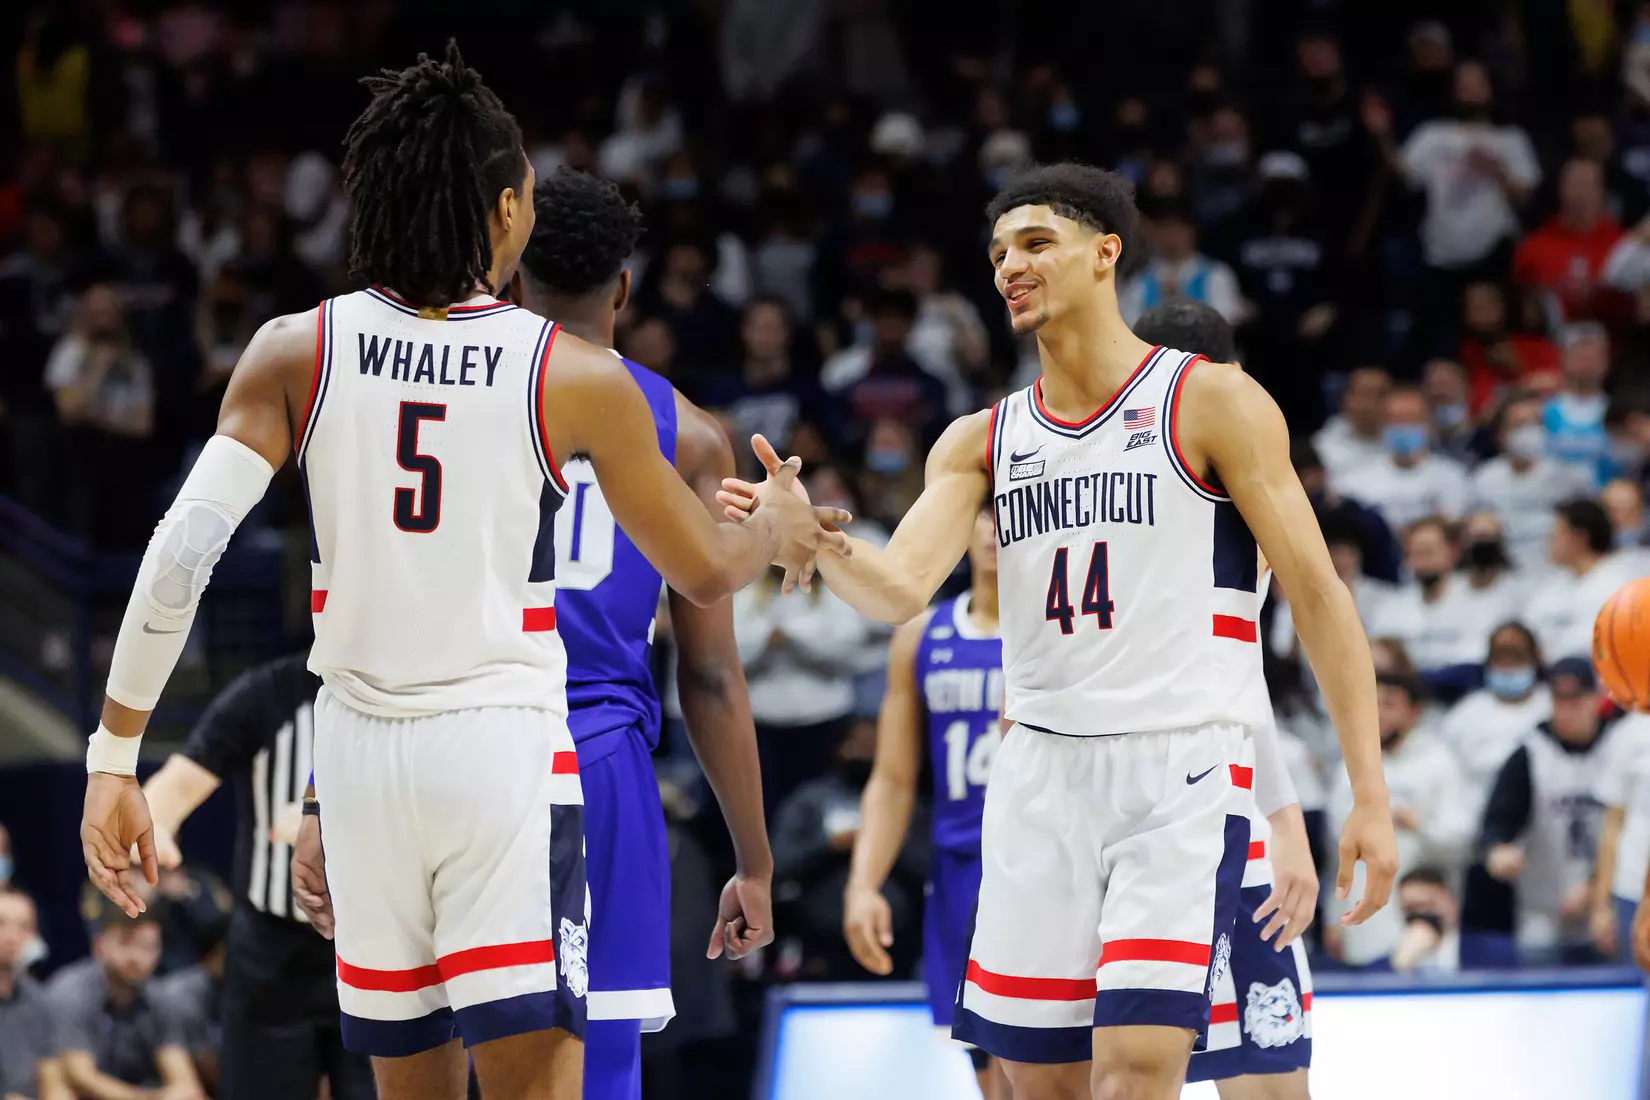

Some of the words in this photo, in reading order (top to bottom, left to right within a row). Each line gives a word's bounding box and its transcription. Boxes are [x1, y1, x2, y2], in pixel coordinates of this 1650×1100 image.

[358, 332, 504, 387] WHALEY
[393, 400, 447, 534] 5
[1126, 435, 1159, 448] EAST
[1129, 430, 1153, 441] BIG
[994, 472, 1158, 549] CONNECTICUT
[1045, 541, 1115, 636] 44
